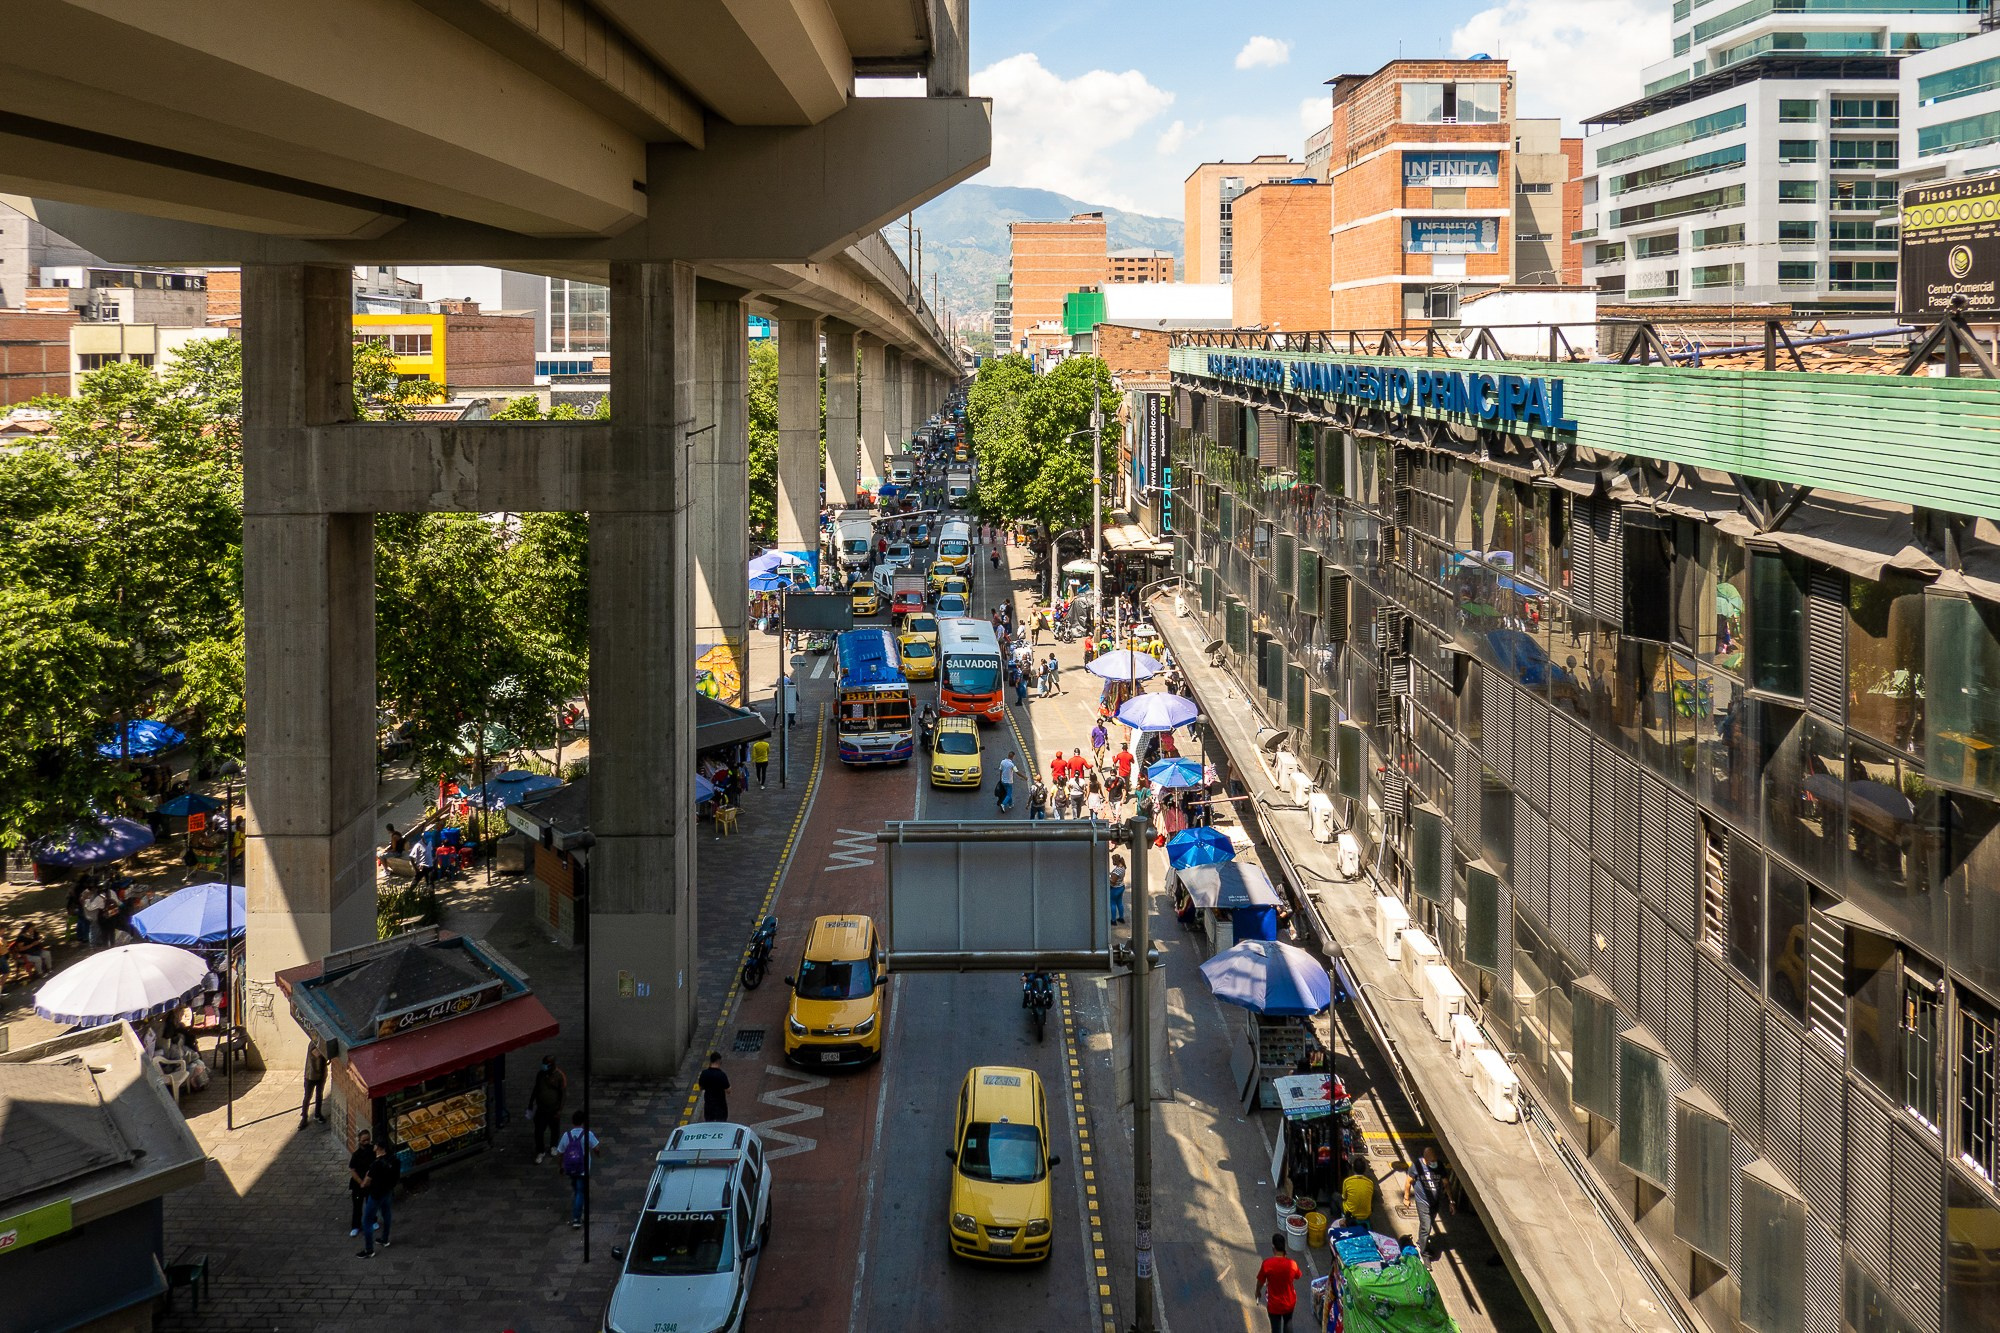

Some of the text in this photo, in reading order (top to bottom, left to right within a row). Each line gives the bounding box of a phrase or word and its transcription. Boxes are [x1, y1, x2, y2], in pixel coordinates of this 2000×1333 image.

[1404, 161, 1493, 176] INFINITA
[1918, 181, 1996, 203] Pisos 1-2-3-4
[1417, 222, 1477, 230] INFINITA
[1928, 281, 1994, 294] Centro Comercial
[1417, 369, 1578, 431] PRINCIPAL
[946, 659, 998, 669] SALVADOR
[846, 690, 904, 701] BELEN
[399, 1012, 428, 1028] Que
[684, 1132, 724, 1142] 37-3848
[657, 1213, 715, 1222] POLICIA
[653, 1322, 678, 1333] 37-3848
